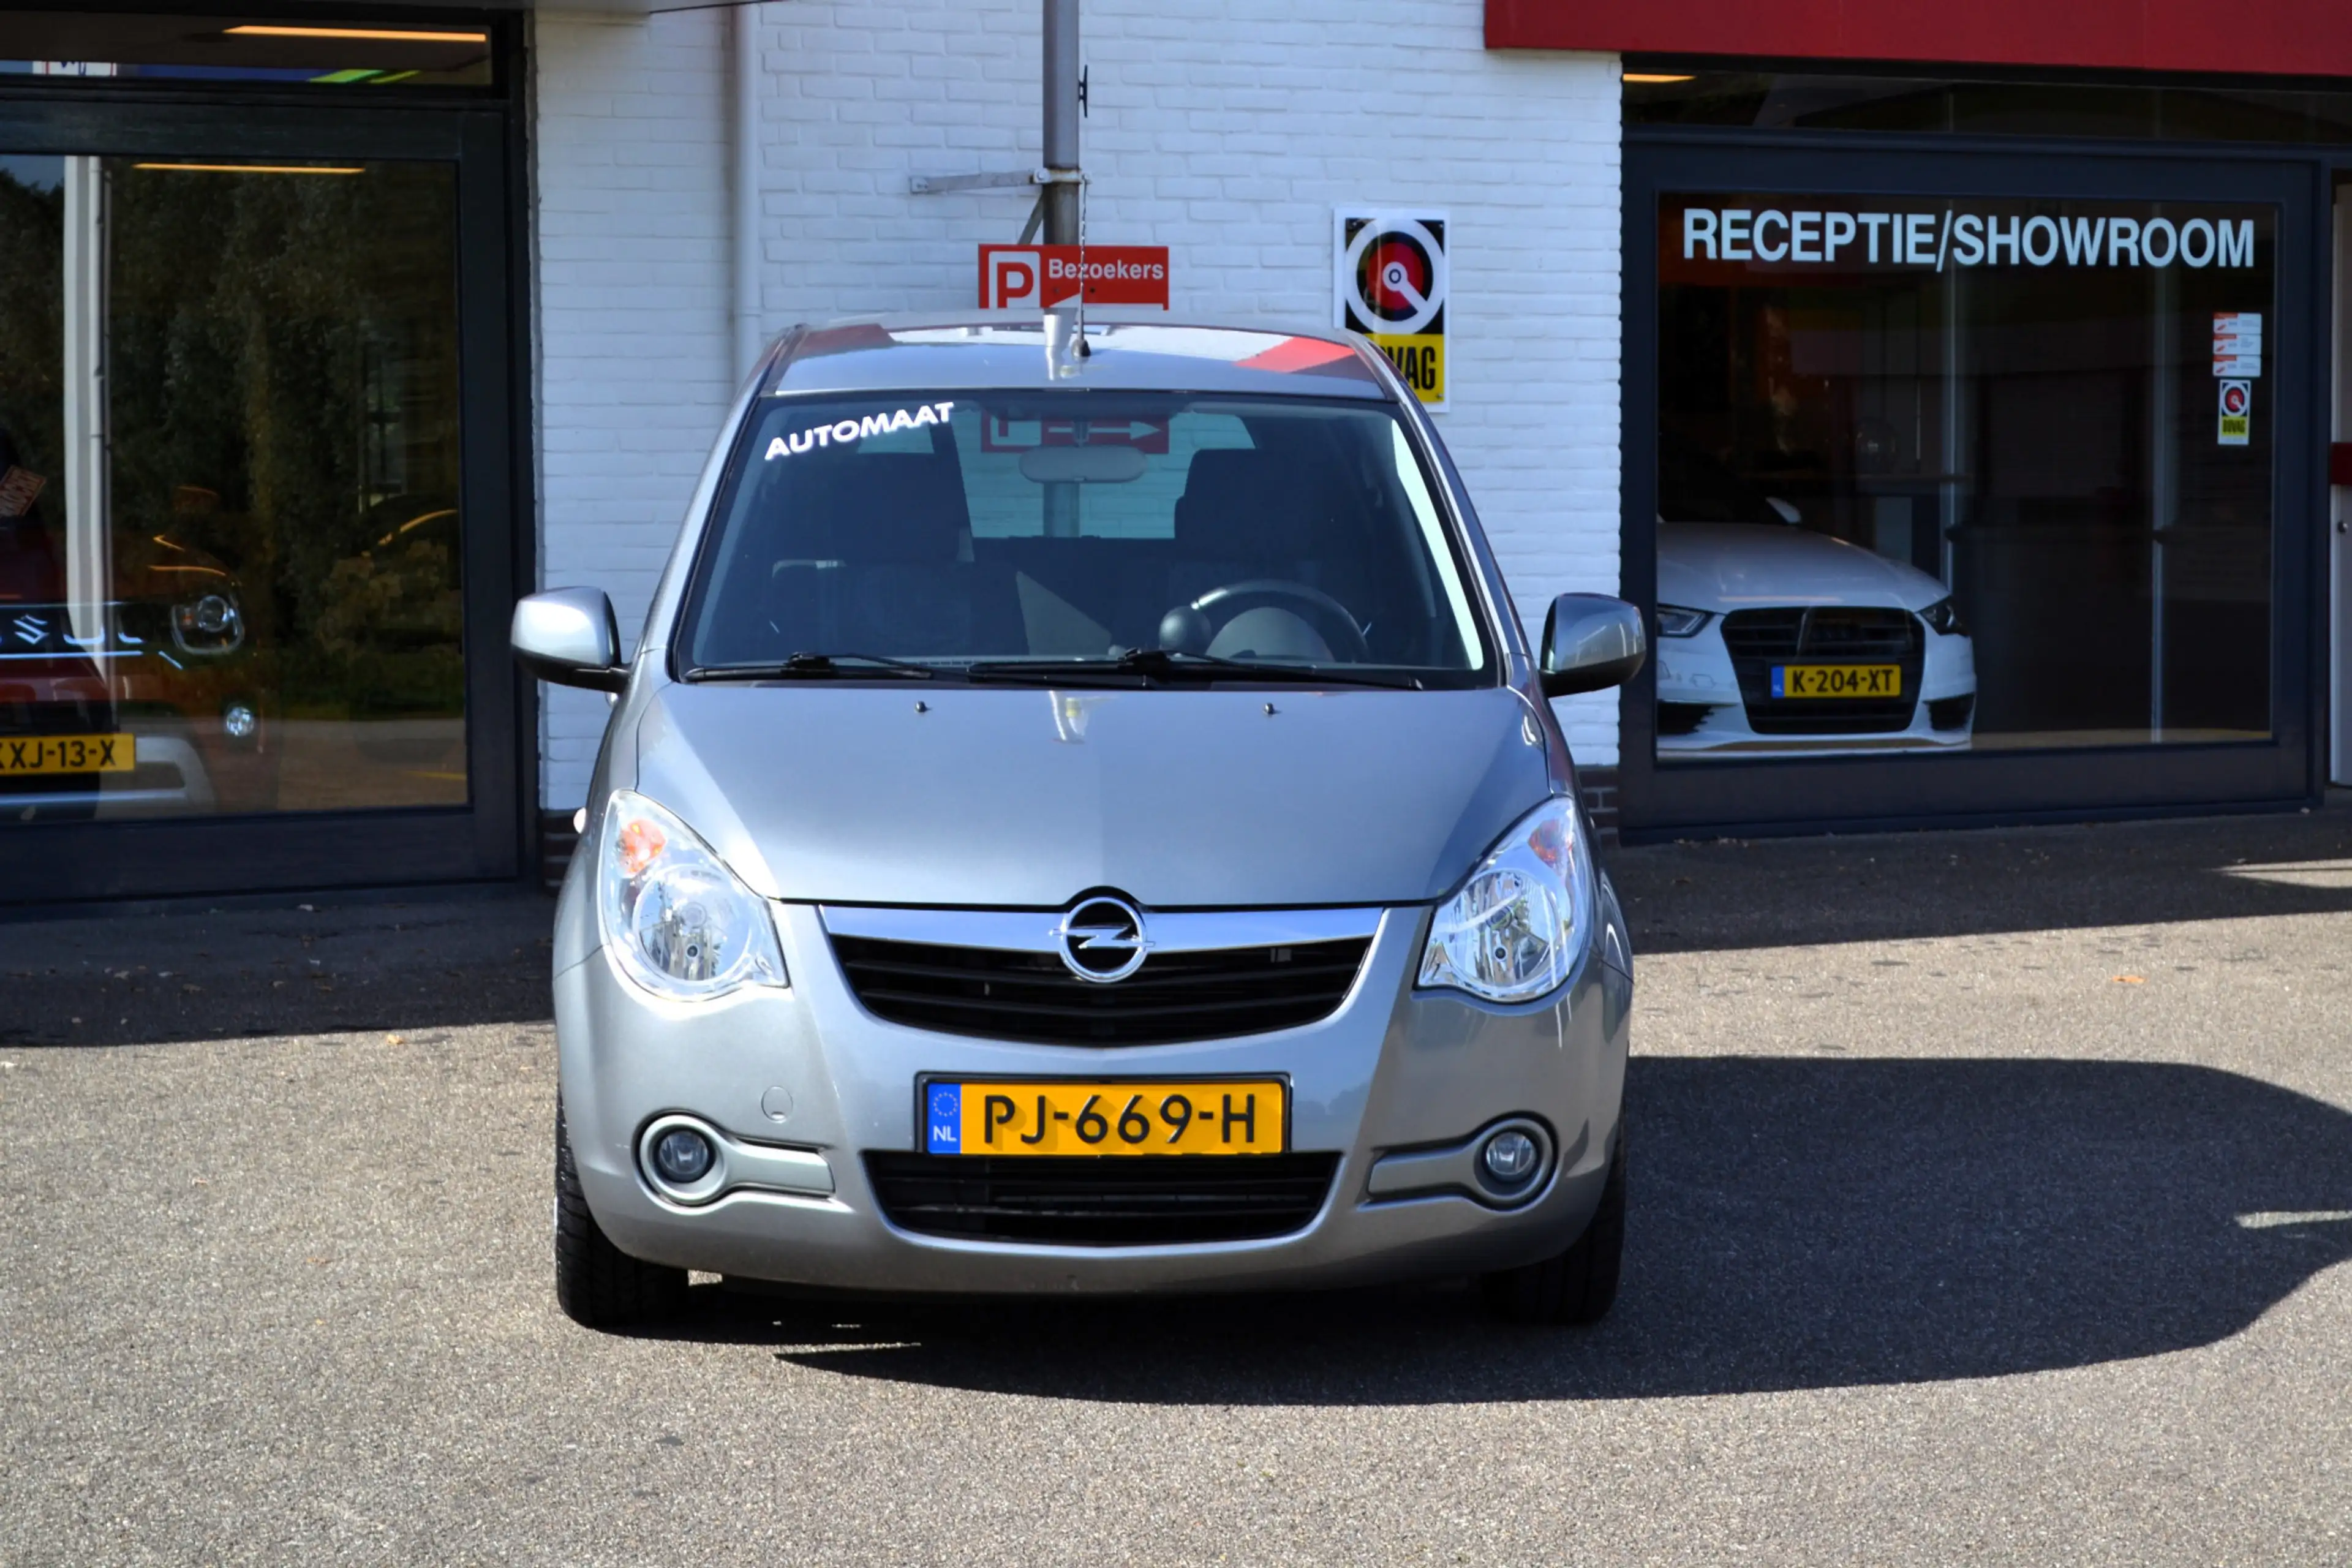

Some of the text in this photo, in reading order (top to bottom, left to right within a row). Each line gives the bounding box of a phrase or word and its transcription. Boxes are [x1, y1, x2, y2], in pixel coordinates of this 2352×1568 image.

[1683, 208, 2255, 273] RECEPTIE/SHOWROOM
[1049, 258, 1164, 279] Bezoekers
[1381, 346, 1436, 390] VAG
[764, 401, 954, 461] AUTOMAAT
[1792, 669, 1894, 693] K-204-XT
[933, 1094, 1256, 1144] NL PJ-669-H
